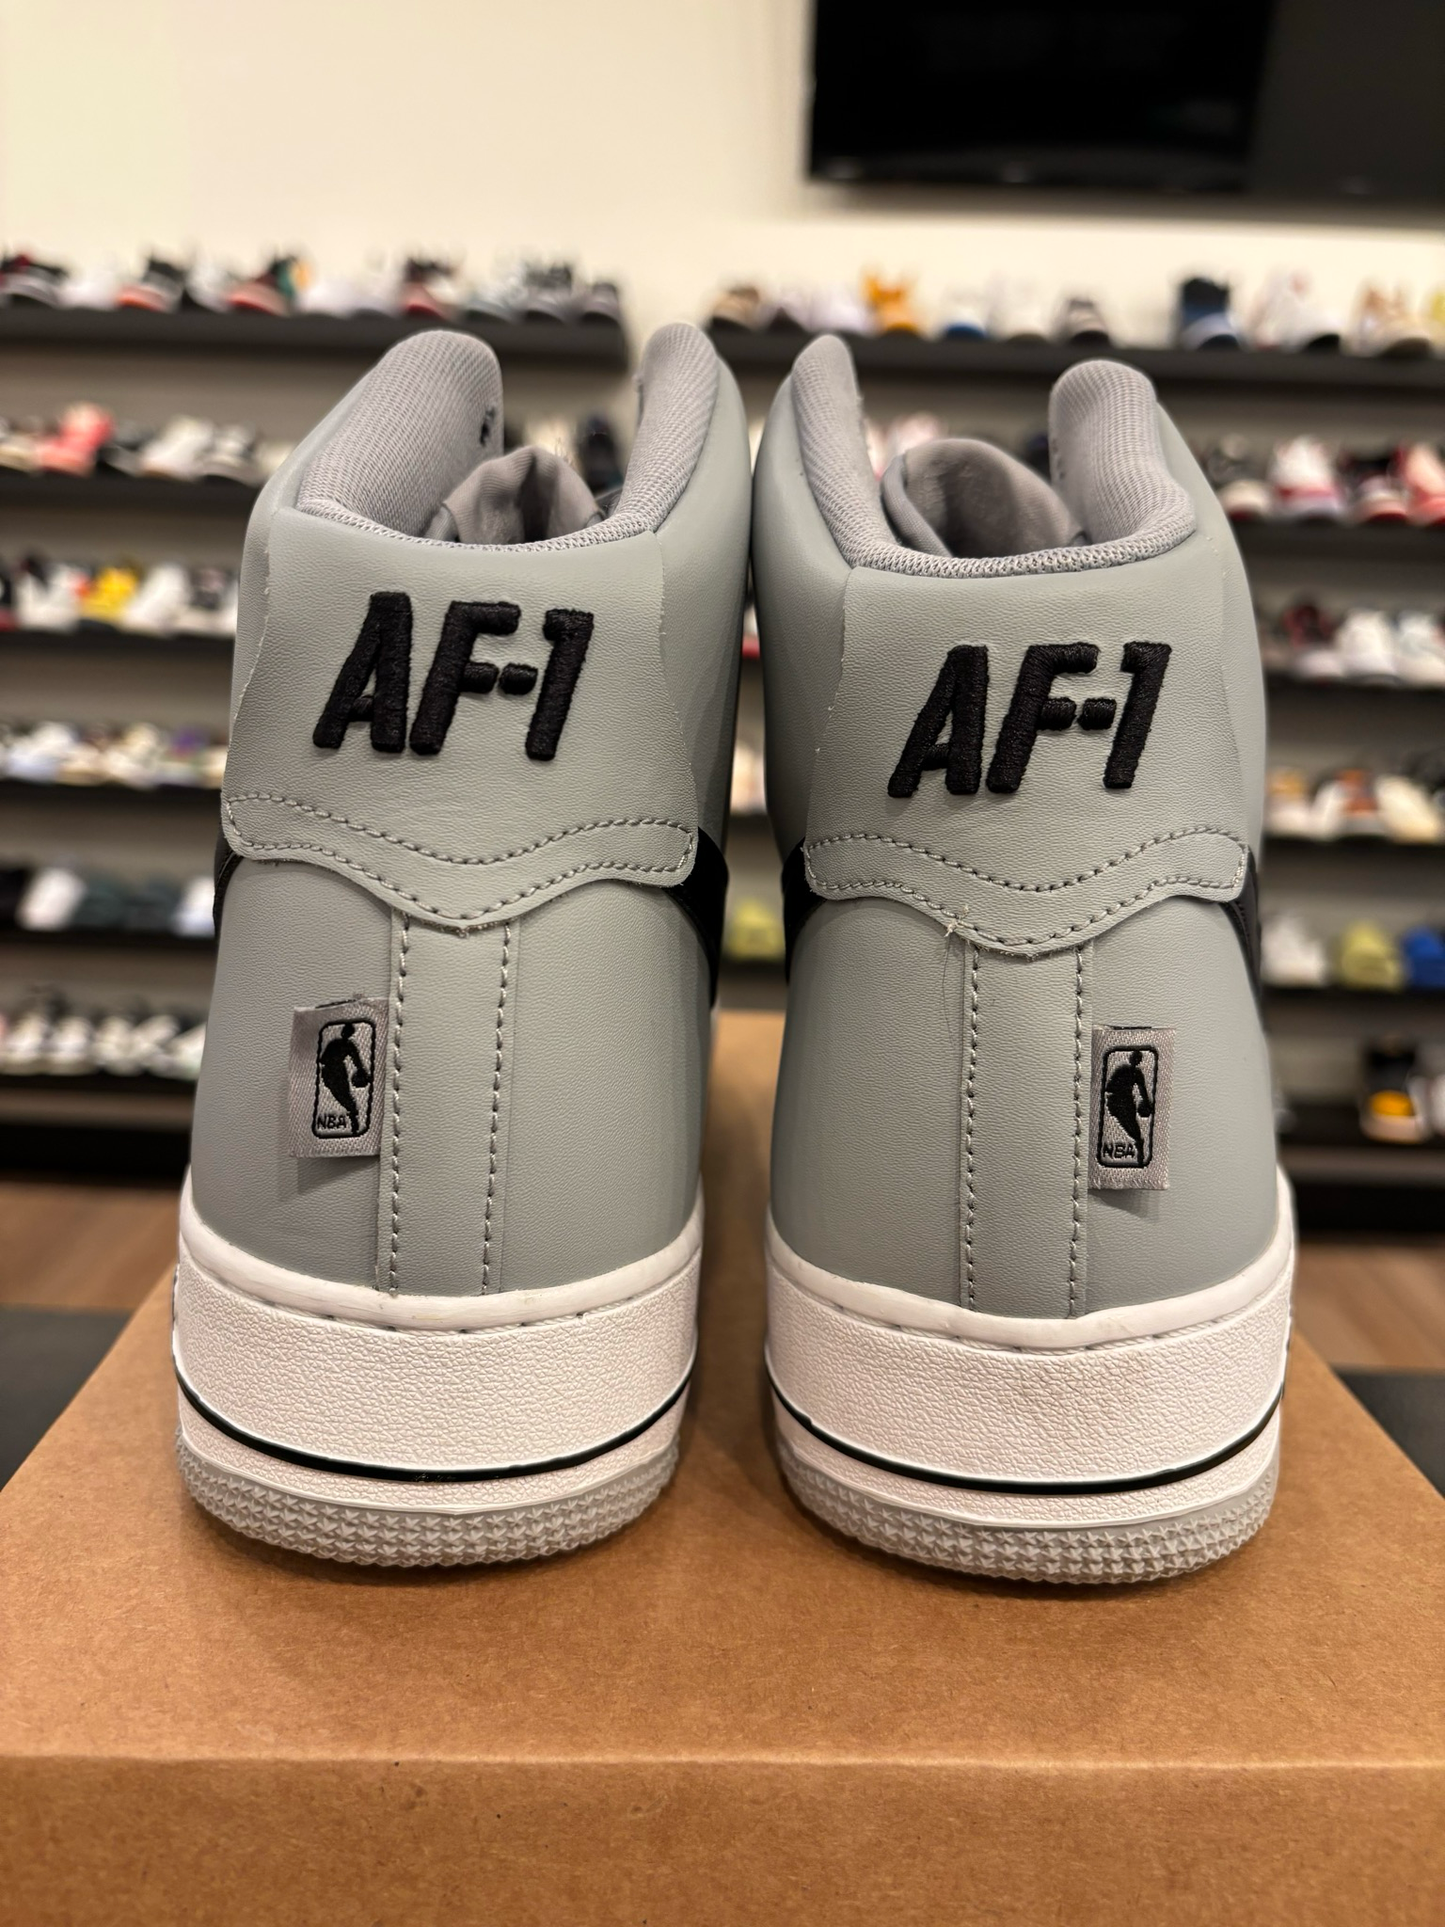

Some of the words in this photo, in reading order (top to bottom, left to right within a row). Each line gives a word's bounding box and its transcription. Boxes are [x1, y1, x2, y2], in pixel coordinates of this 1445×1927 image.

[312, 591, 595, 763] AF-1
[886, 640, 1173, 802] AF-1
[316, 1114, 347, 1130] NBA
[1102, 1142, 1135, 1159] NBA
